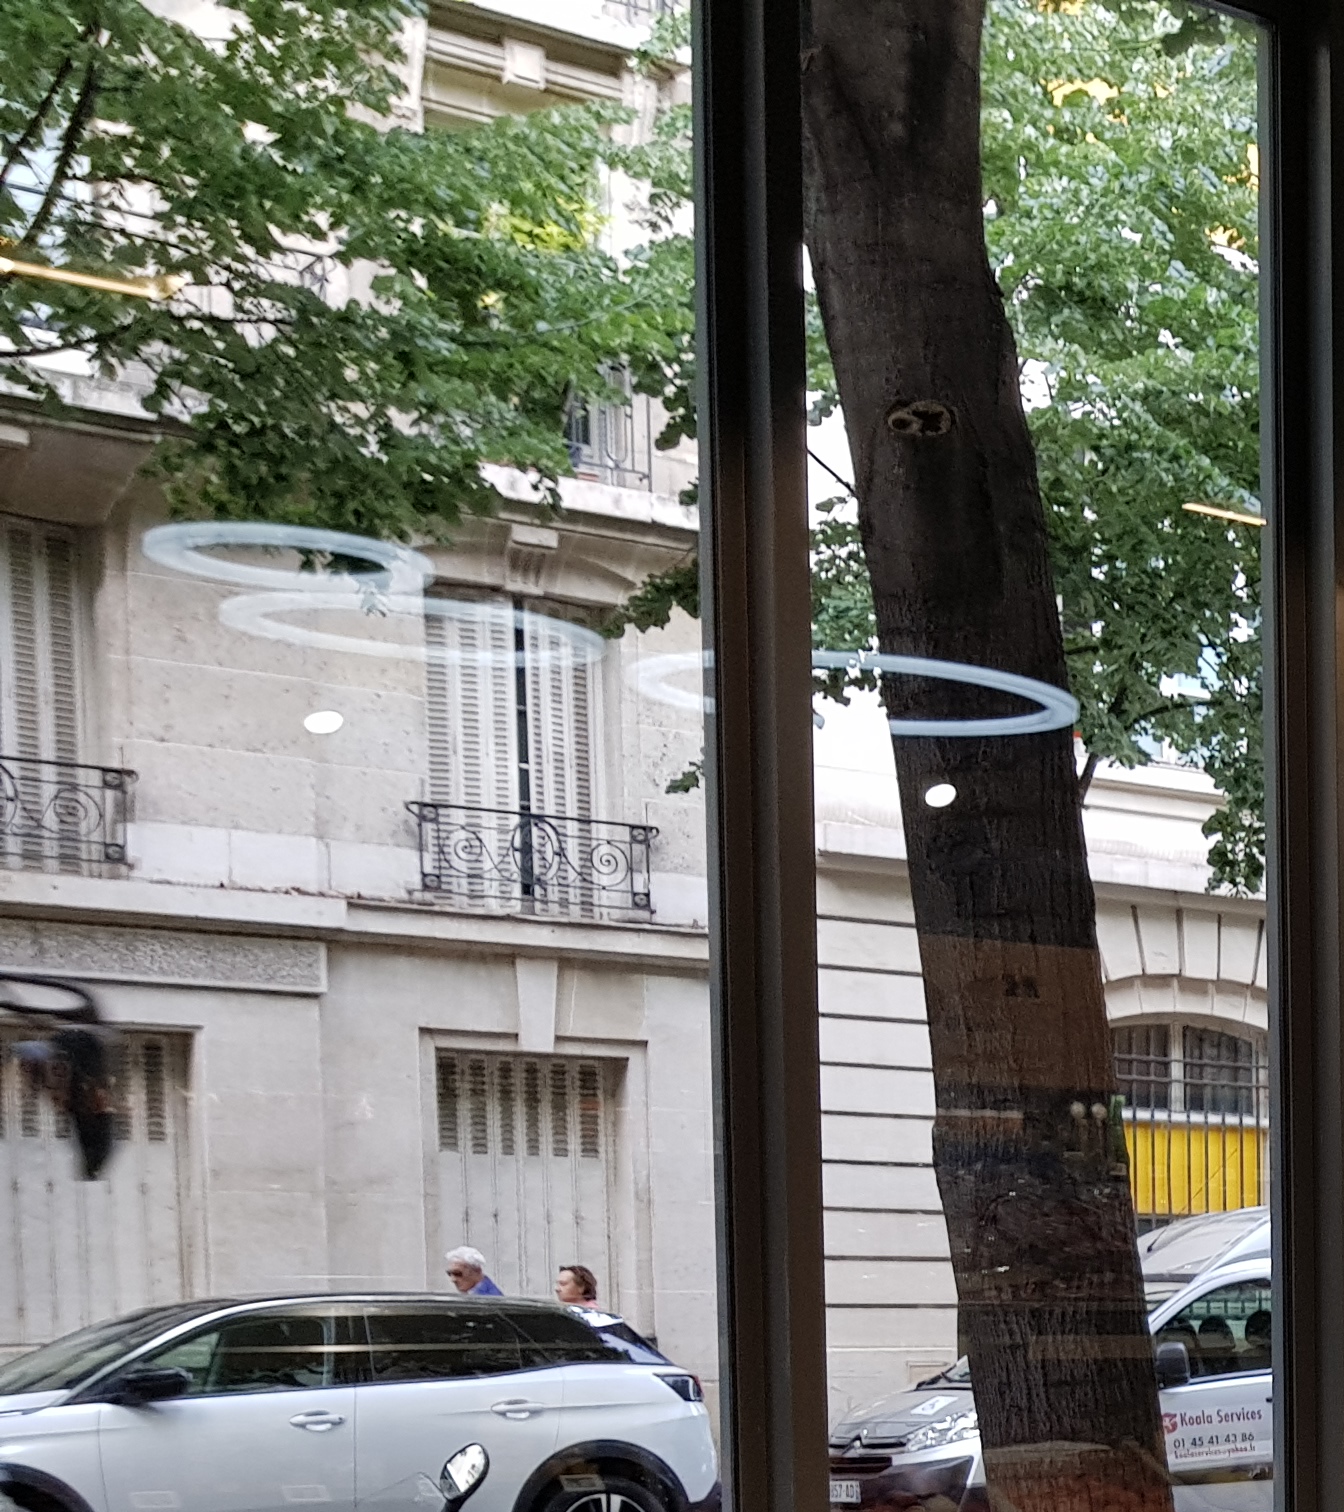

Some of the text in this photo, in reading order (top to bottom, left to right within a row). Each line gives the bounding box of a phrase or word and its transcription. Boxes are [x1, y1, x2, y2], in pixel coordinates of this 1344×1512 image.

[1180, 1406, 1262, 1427] Koala Services
[1173, 1438, 1185, 1449] 01
